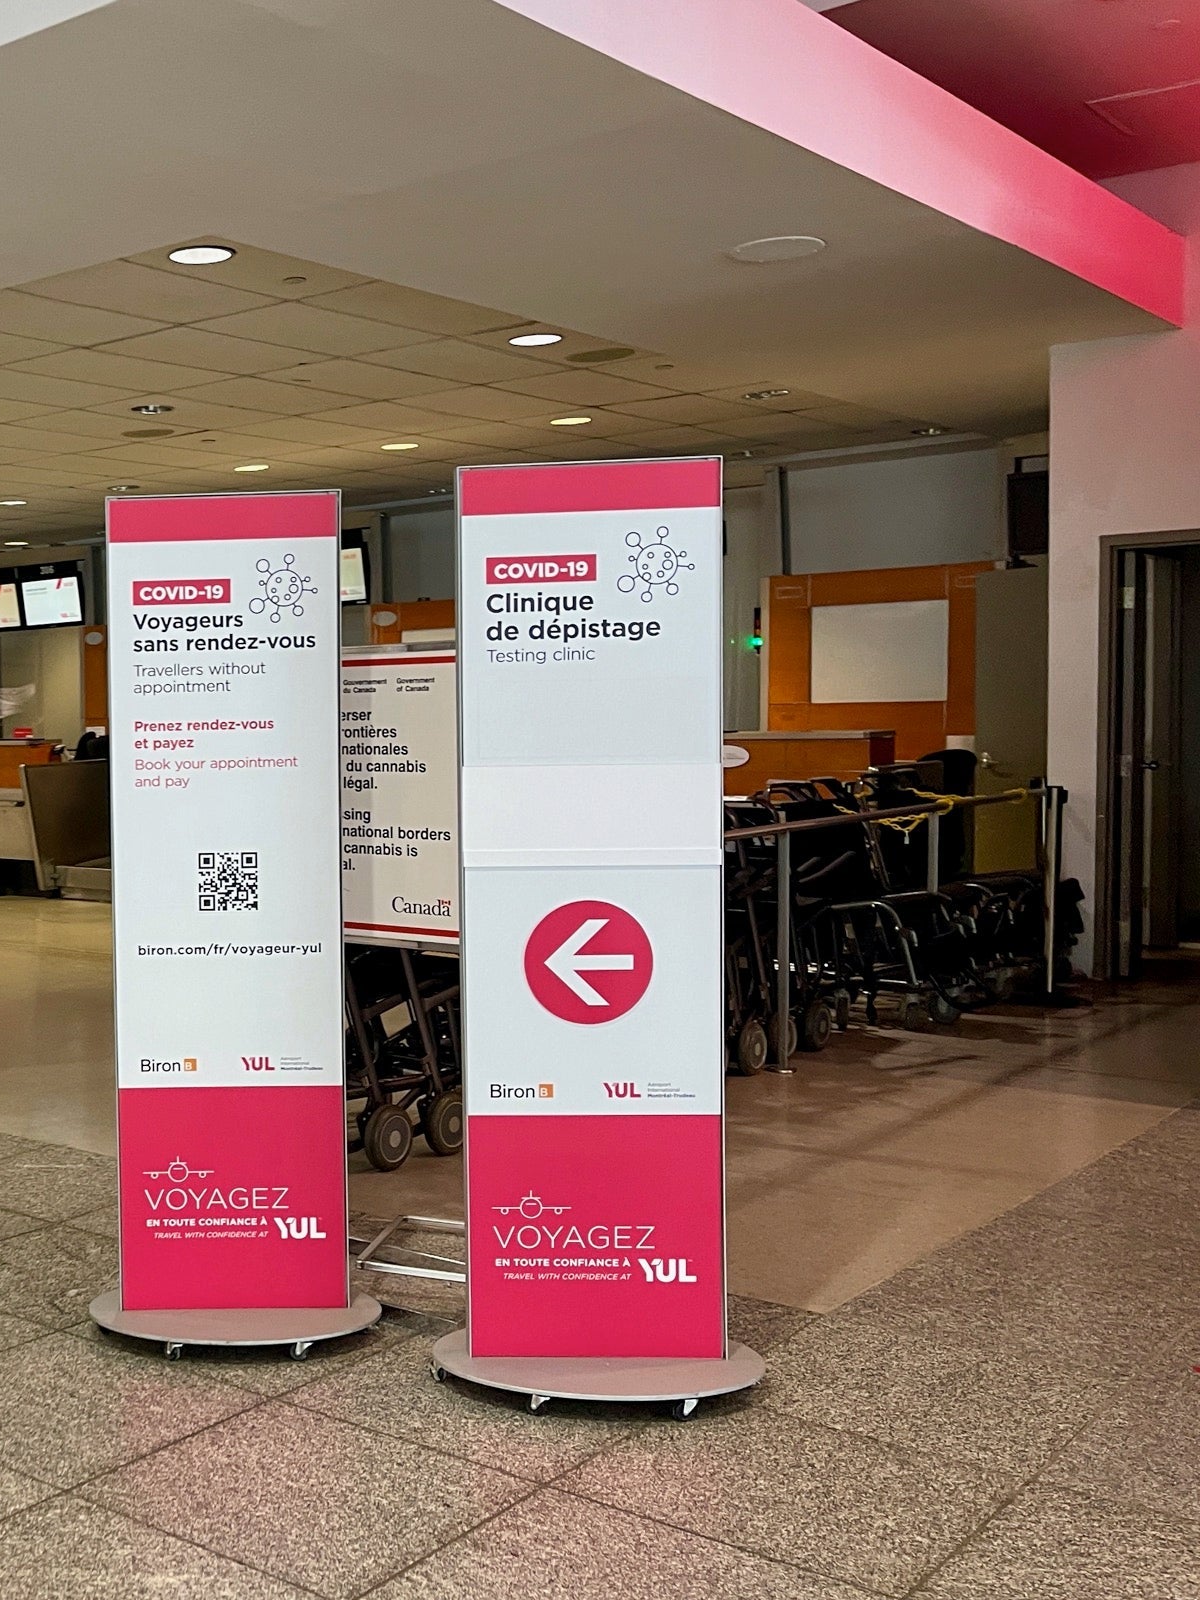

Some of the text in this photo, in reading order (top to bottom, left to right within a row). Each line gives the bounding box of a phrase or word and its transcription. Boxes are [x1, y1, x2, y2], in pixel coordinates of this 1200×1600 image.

[493, 561, 589, 580] COVID-19
[139, 584, 224, 602] COVID-19
[486, 592, 594, 615] Clinique
[133, 612, 244, 632] Voyageurs
[486, 619, 661, 643] de dépistage
[133, 632, 316, 652] sans rendez-vous
[487, 647, 596, 664] Testing clinic
[134, 662, 266, 677] Travellers without
[133, 680, 231, 695] appointment
[134, 718, 274, 732] Prenez rendez-vous
[342, 725, 397, 738] ontières
[134, 738, 194, 751] et payez
[135, 756, 298, 772] Book your appointment
[346, 760, 426, 773] du cannabis
[135, 776, 190, 790] and pay
[398, 827, 451, 841] borders
[344, 843, 418, 857] cannabis is
[392, 896, 451, 917] Canada
[138, 942, 322, 957] biron.com/fr/voyageur-yul
[141, 1059, 181, 1072] Biron
[241, 1057, 275, 1071] YUL
[490, 1084, 535, 1098] Biron
[602, 1082, 641, 1098] YUL
[144, 1187, 289, 1210] VOYAGEZ
[146, 1215, 268, 1227] EN TOUTE CONFIANCE À
[274, 1216, 326, 1239] YUL
[153, 1230, 268, 1239] TRAVEL WITH CONFIDENCE AT
[493, 1225, 655, 1249] VOYAGEZ
[495, 1257, 631, 1267] EN TOUTE CONFIANCE À
[561, 1272, 618, 1281] CONFIDENCE
[619, 1272, 632, 1280] AT
[638, 1258, 697, 1283] YUL
